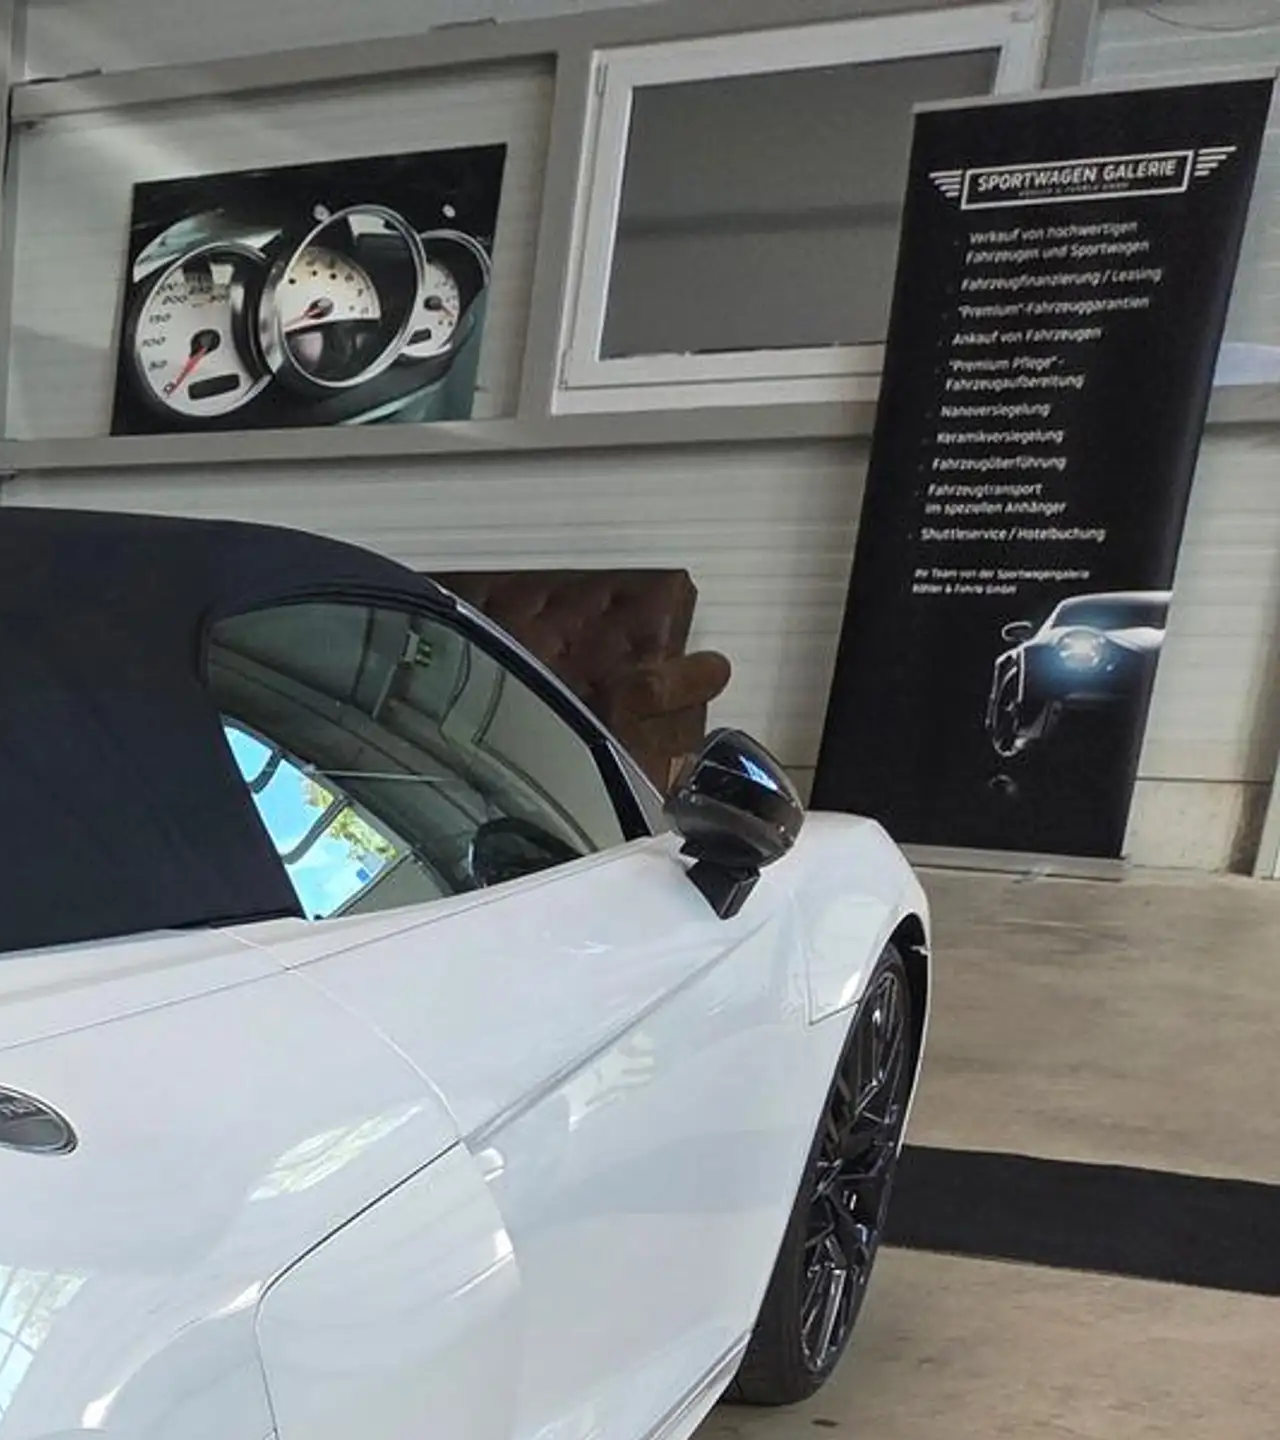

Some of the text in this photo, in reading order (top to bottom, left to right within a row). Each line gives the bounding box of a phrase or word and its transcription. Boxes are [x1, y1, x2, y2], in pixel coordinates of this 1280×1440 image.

[977, 164, 1097, 193] SPORTWAGEN
[1104, 159, 1177, 182] GALERIE
[1112, 268, 1162, 284] Leasing
[952, 327, 1102, 346] Ankauf von Fahrzeugen
[936, 429, 1065, 445] Keramikversiegelung
[927, 483, 1043, 499] Fahrzeugtransport
[1004, 500, 1067, 517] Anhänger
[920, 527, 1008, 542] Shuttleservice
[1017, 526, 1107, 543] Hotelbuchung
